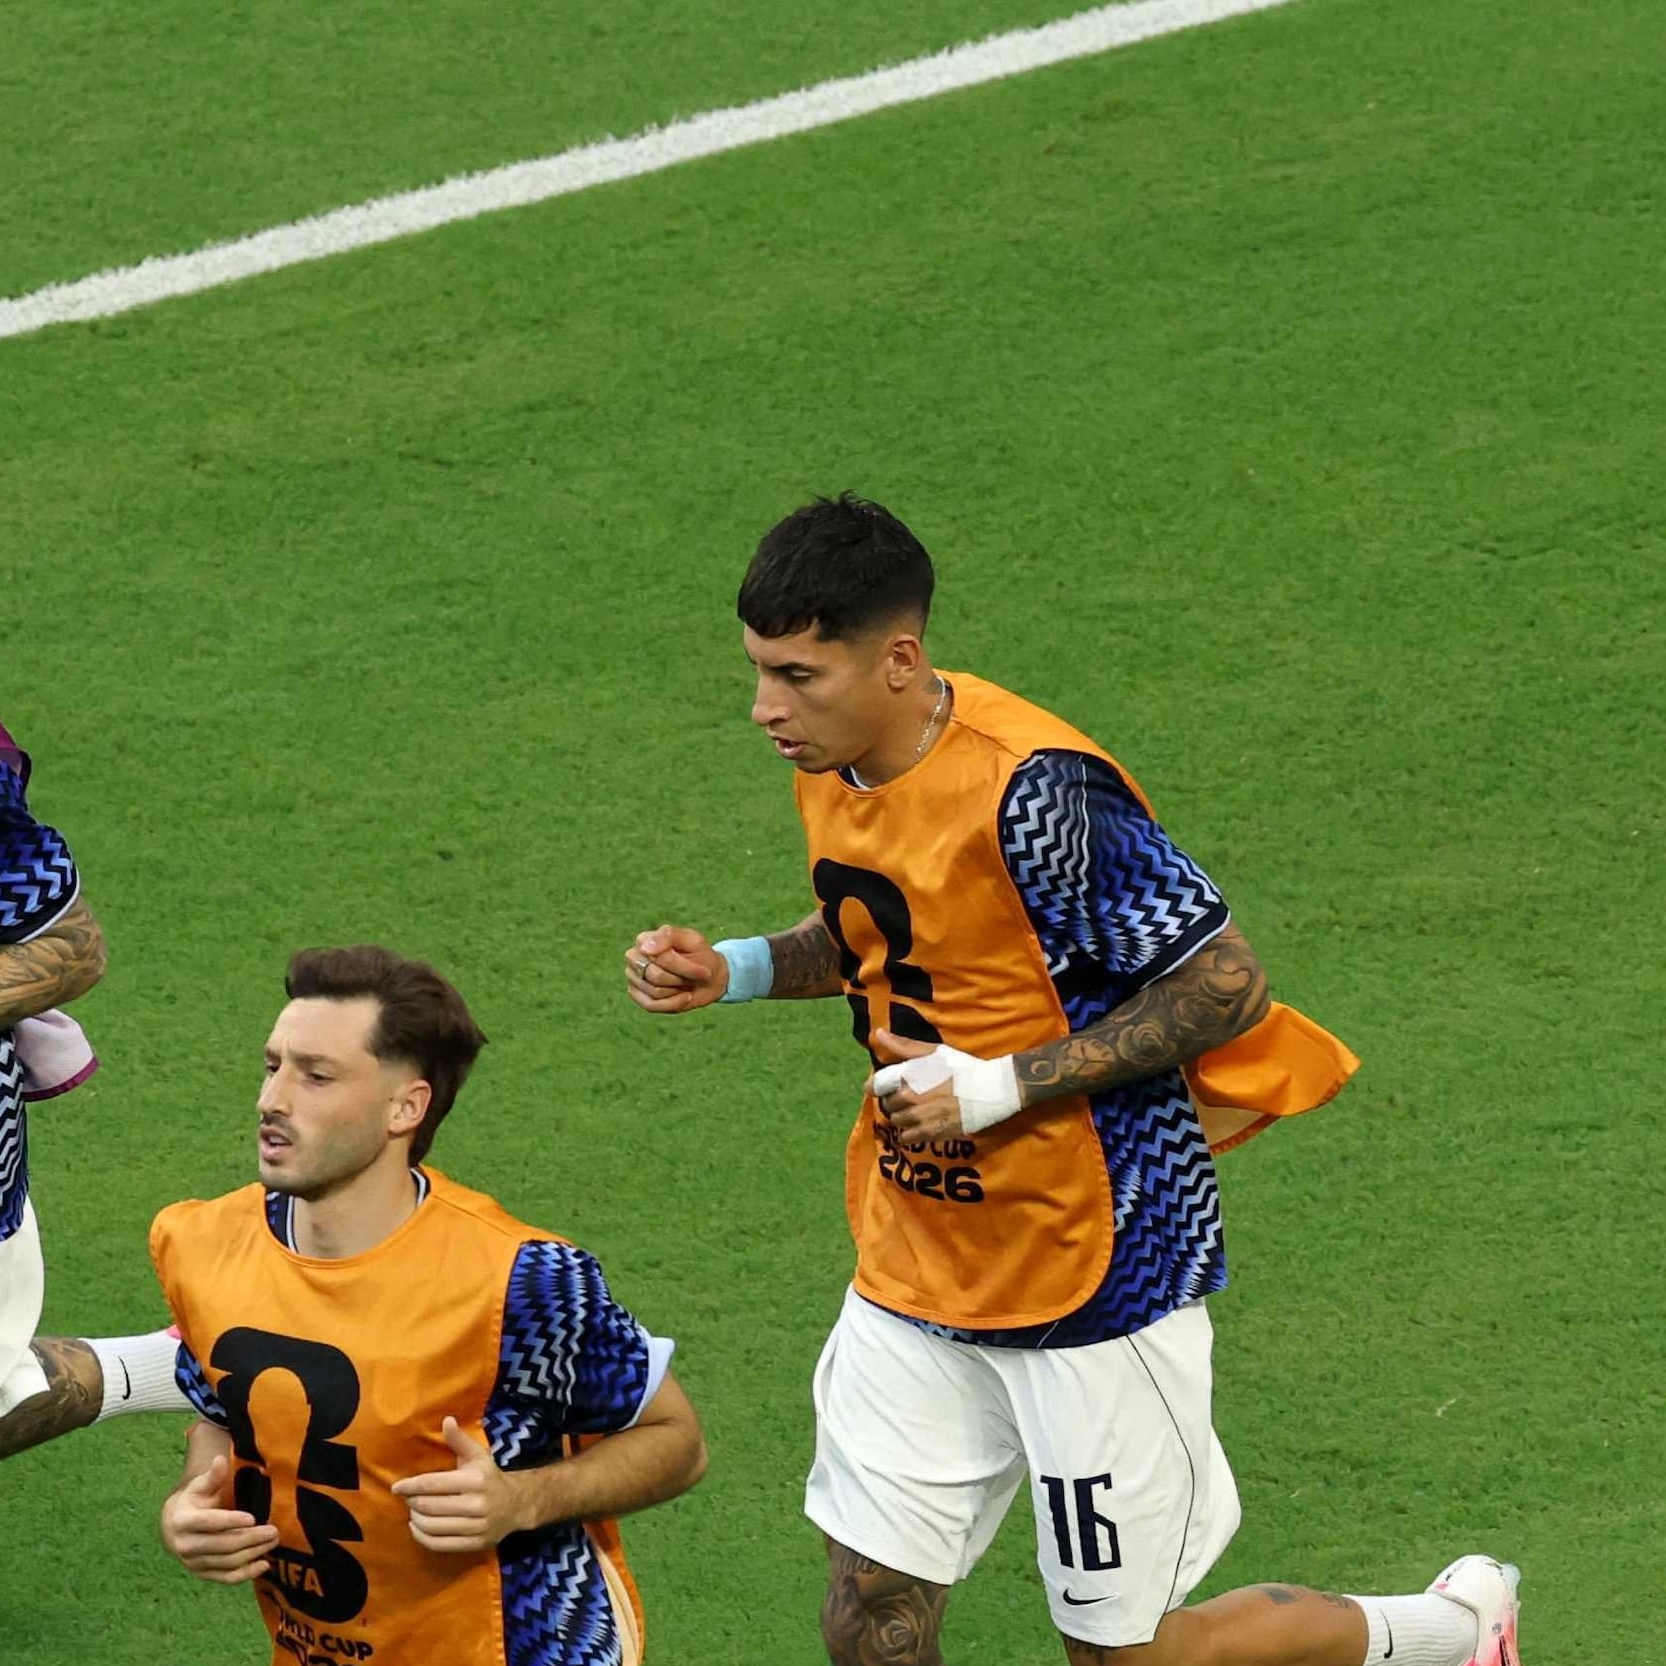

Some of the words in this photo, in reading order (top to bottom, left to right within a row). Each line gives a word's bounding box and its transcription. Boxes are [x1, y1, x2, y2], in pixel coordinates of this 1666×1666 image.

[878, 1146, 985, 1203] 2026
[1040, 1473, 1121, 1571] 16
[276, 1558, 325, 1598] IFA
[319, 1633, 374, 1661] CUP
